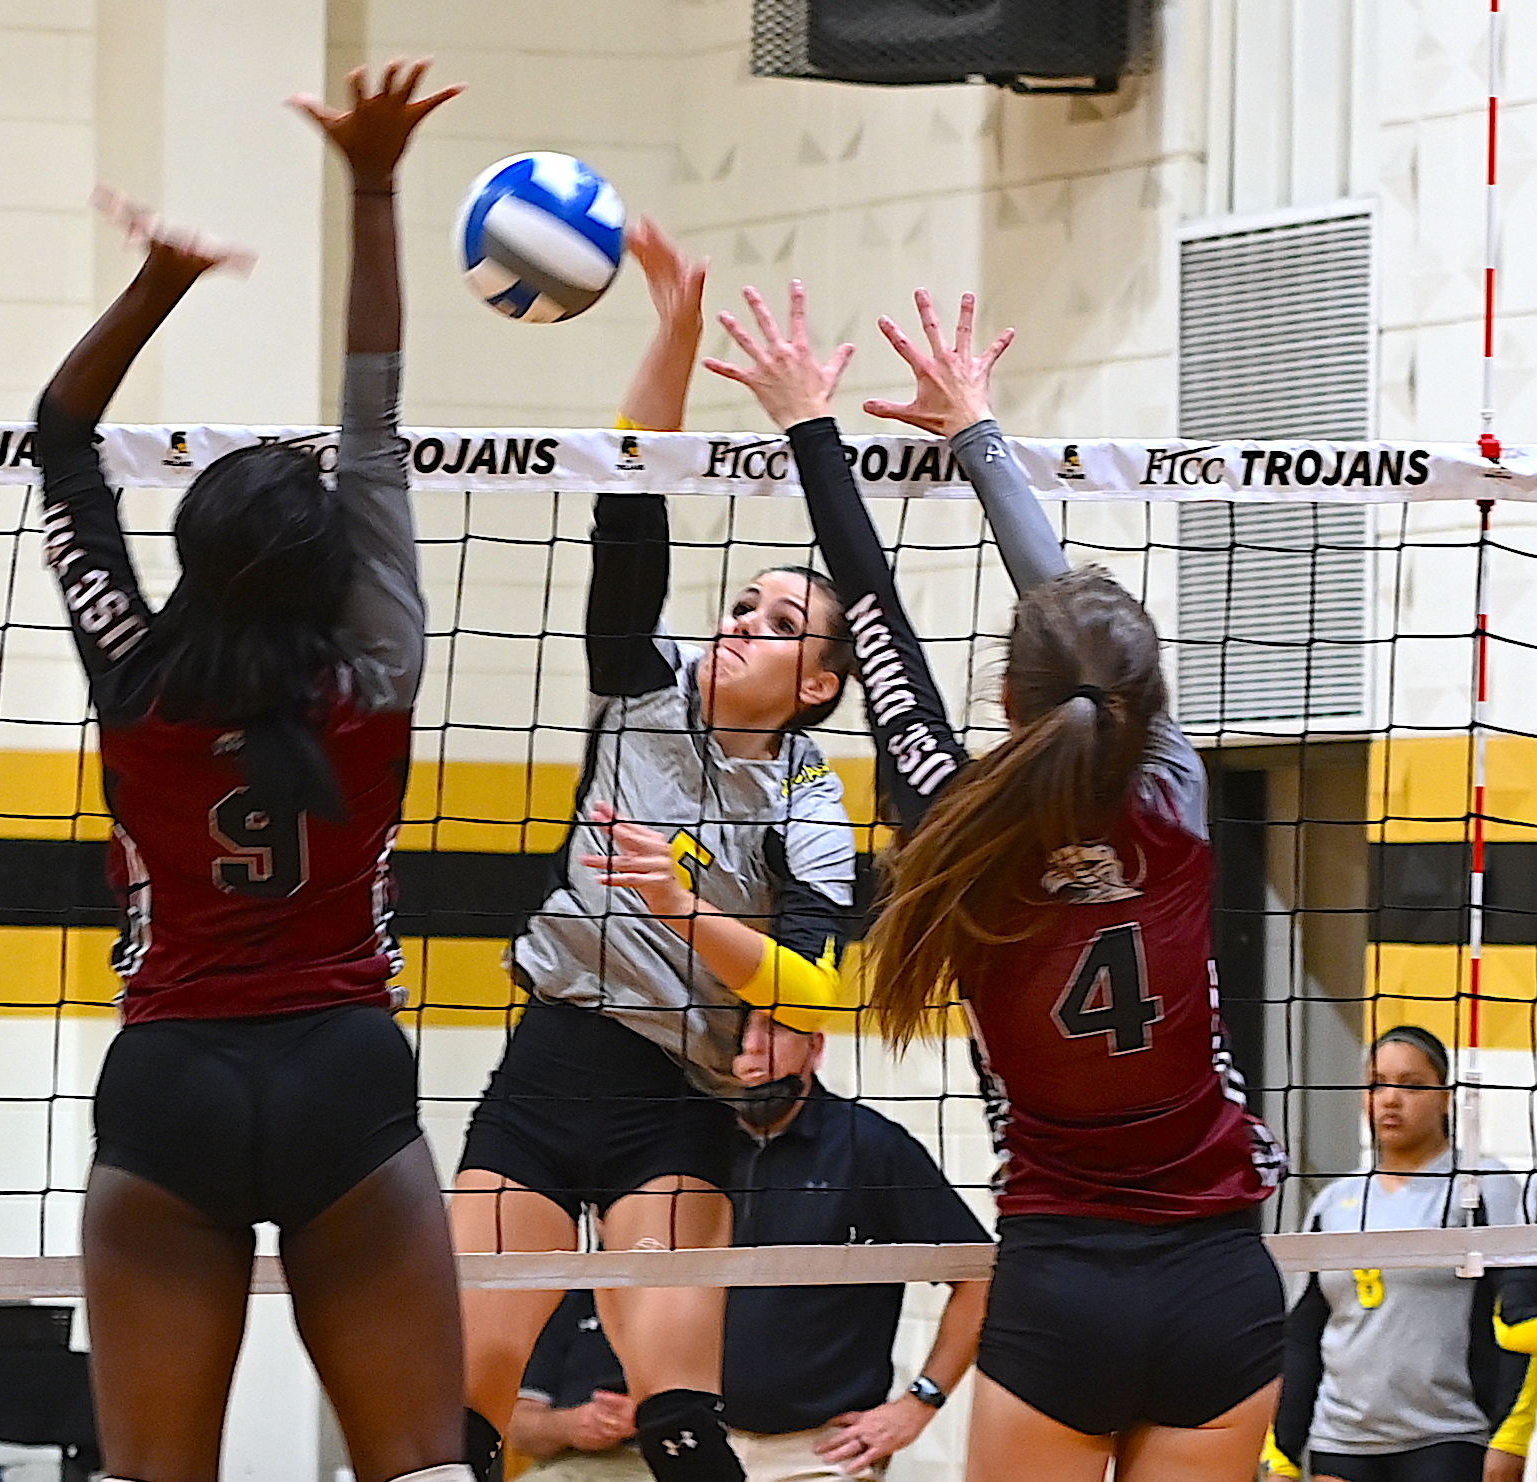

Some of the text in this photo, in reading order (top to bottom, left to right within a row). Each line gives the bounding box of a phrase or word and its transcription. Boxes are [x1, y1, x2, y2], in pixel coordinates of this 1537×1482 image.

[402, 437, 559, 475] OJANS
[1240, 449, 1431, 487] TROJANS
[65, 569, 150, 662] USC
[844, 592, 959, 797] USC UNION
[208, 785, 311, 899] 9
[1050, 920, 1166, 1057] 4
